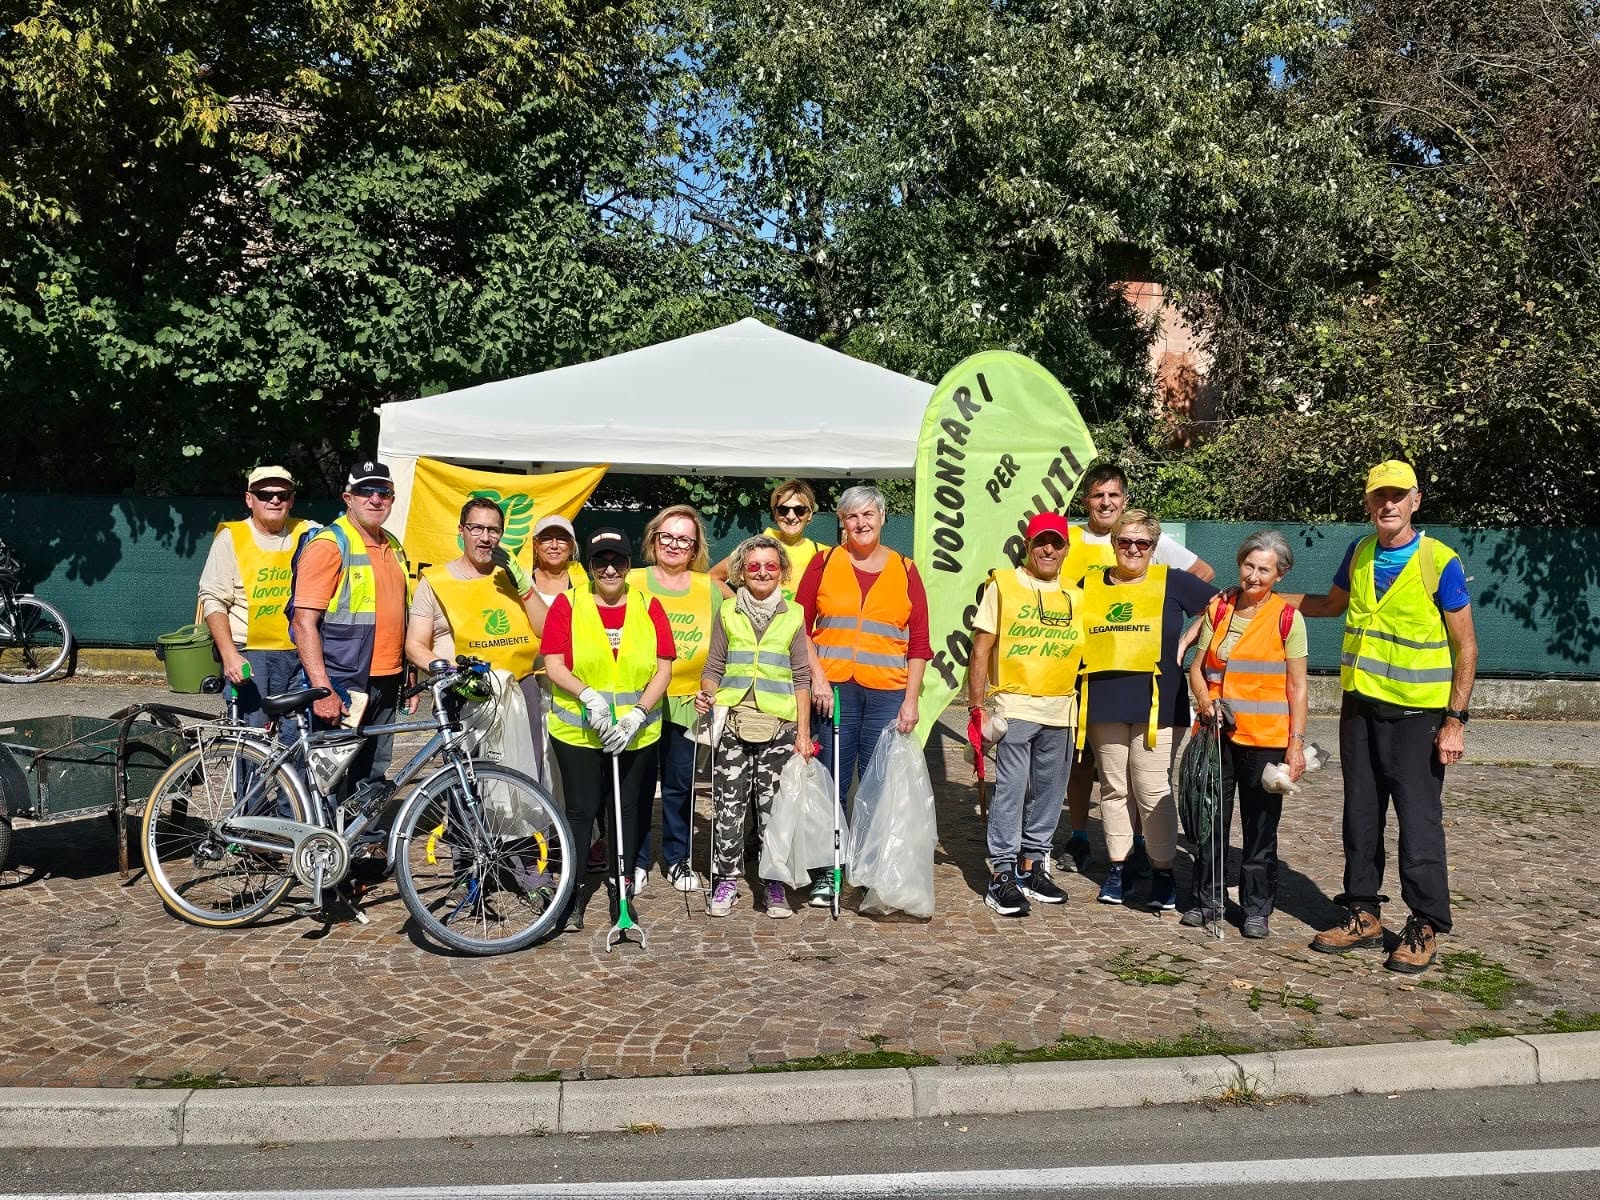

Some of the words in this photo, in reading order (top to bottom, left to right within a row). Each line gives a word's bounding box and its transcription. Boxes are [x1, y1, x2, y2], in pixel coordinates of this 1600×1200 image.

[932, 373, 993, 573] VOLONTARI
[985, 453, 1021, 503] PER
[255, 604, 282, 620] per
[1008, 622, 1078, 640] lavorando
[1089, 625, 1150, 634] LEGAMBIENTE
[469, 636, 529, 648] LEGAMBIENTE
[1007, 644, 1037, 659] per
